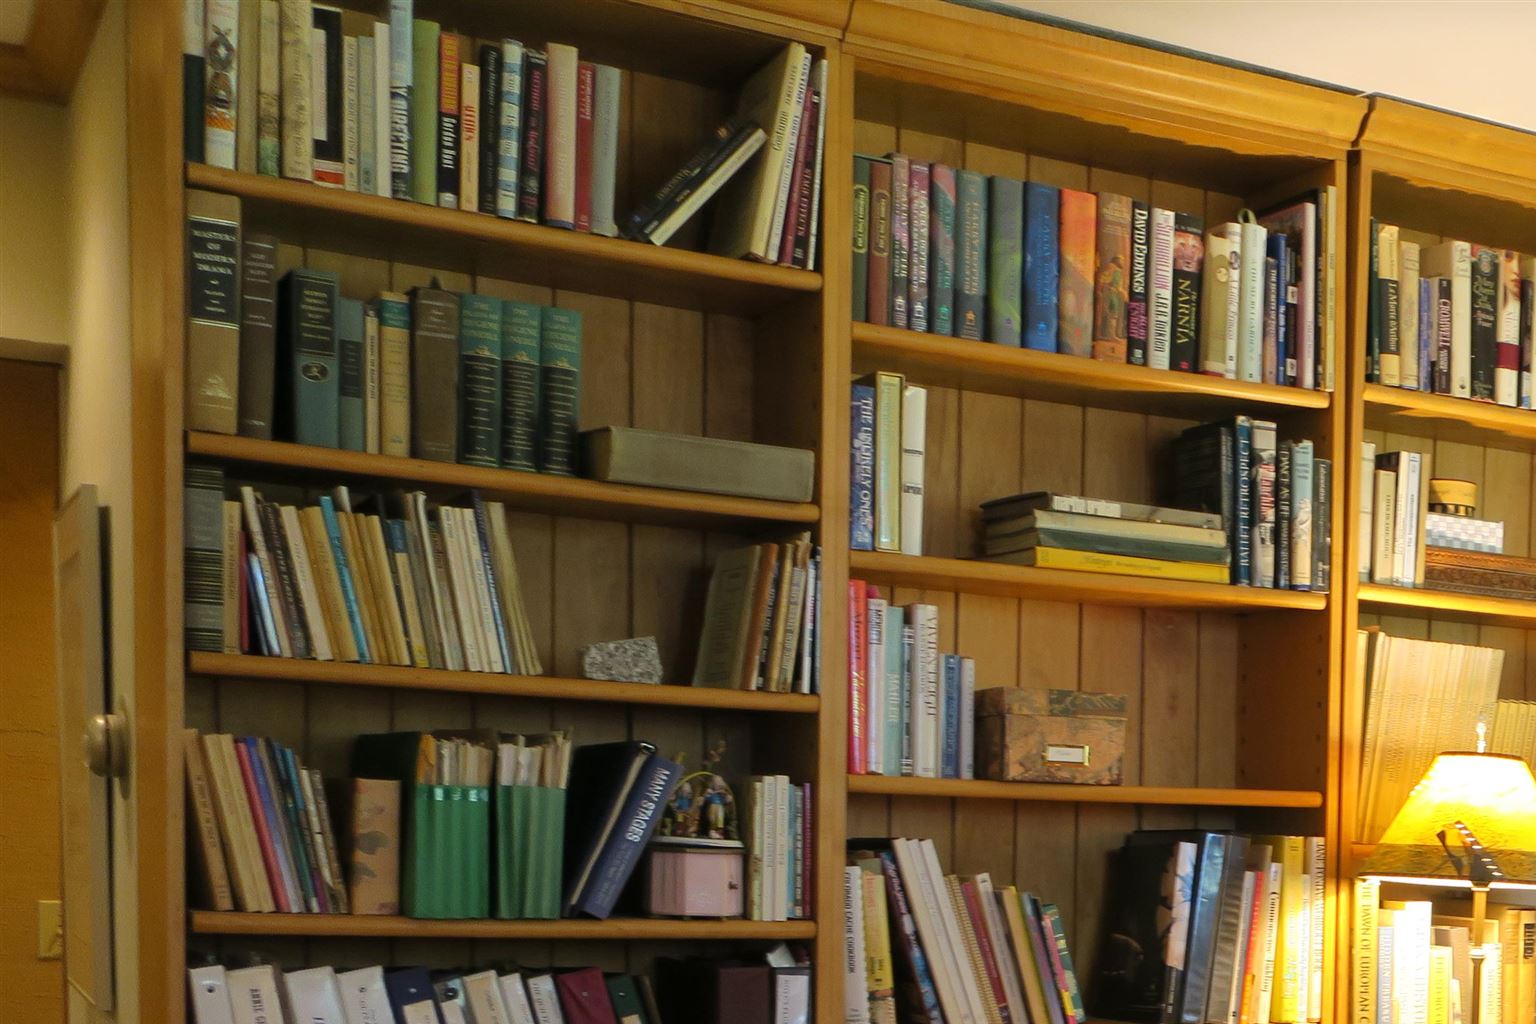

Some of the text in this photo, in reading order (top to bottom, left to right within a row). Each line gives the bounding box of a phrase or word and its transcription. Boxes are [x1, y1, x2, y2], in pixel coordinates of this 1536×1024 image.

[391, 100, 410, 173] DIRECTING
[441, 117, 457, 168] Gordon Hunt
[192, 228, 237, 242] MASTERS
[972, 202, 980, 245] HARRY
[191, 250, 236, 264] MODERN
[207, 241, 221, 250] OF
[1133, 209, 1148, 293] DAVID EDDINGS
[1154, 223, 1173, 290] SILMARILLION
[195, 263, 232, 275] DRAMA
[1176, 279, 1191, 344] NARNIA
[1438, 299, 1452, 347] CROMWELL
[1154, 320, 1168, 352] Tolkien
[860, 398, 873, 525] THE UNLIKELY ONES
[1280, 451, 1290, 481] DANCE
[1239, 439, 1249, 566] BALLET RETROSPECT
[1280, 487, 1290, 499] AS
[1280, 501, 1290, 517] LIFE
[887, 673, 900, 722] MAHLER
[925, 671, 937, 717] LEIGH
[625, 767, 670, 842] MANY STAGES
[1315, 843, 1325, 864] JANE
[844, 872, 855, 973] COLORADO CACHE COOKBOOK
[1360, 904, 1370, 936] DAWN
[1360, 939, 1370, 952] OF
[1382, 935, 1392, 977] HIDDEN
[250, 987, 270, 1012] ANNIE
[1359, 956, 1370, 1012] EUROPEAN
[1435, 981, 1443, 1011] STORY
